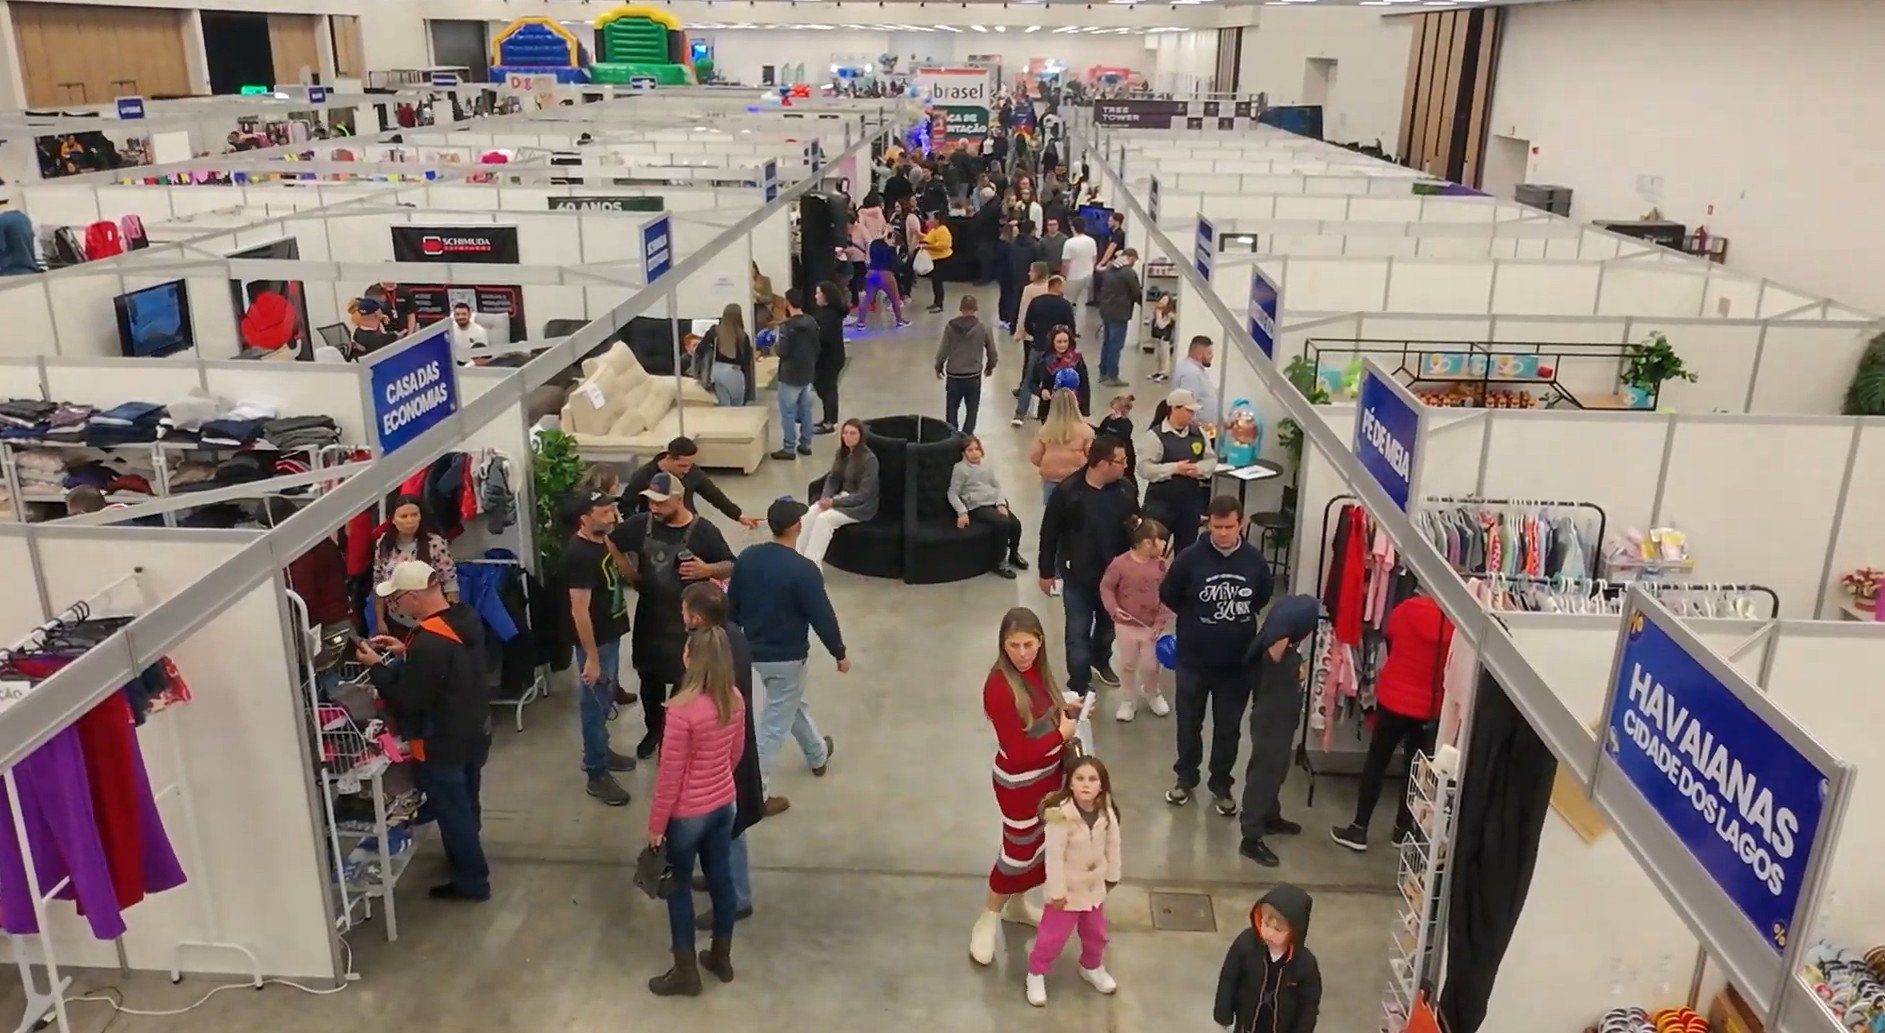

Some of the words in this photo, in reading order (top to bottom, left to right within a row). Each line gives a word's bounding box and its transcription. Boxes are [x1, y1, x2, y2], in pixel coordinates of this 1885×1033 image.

[930, 82, 984, 99] brasel
[1102, 106, 1130, 114] TREE
[442, 237, 491, 246] SCHIMUDA
[386, 372, 419, 405] CASA
[416, 360, 441, 389] DAS
[383, 382, 449, 436] ECONOMIAS
[1362, 407, 1375, 441] PÉ
[1373, 419, 1387, 455] DE
[1385, 432, 1410, 483] MEIA
[1628, 662, 1799, 859] HAVAIANAS
[1623, 708, 1683, 790] CIDADE
[1678, 769, 1717, 826] DOS
[1715, 805, 1786, 897] LAGOS
